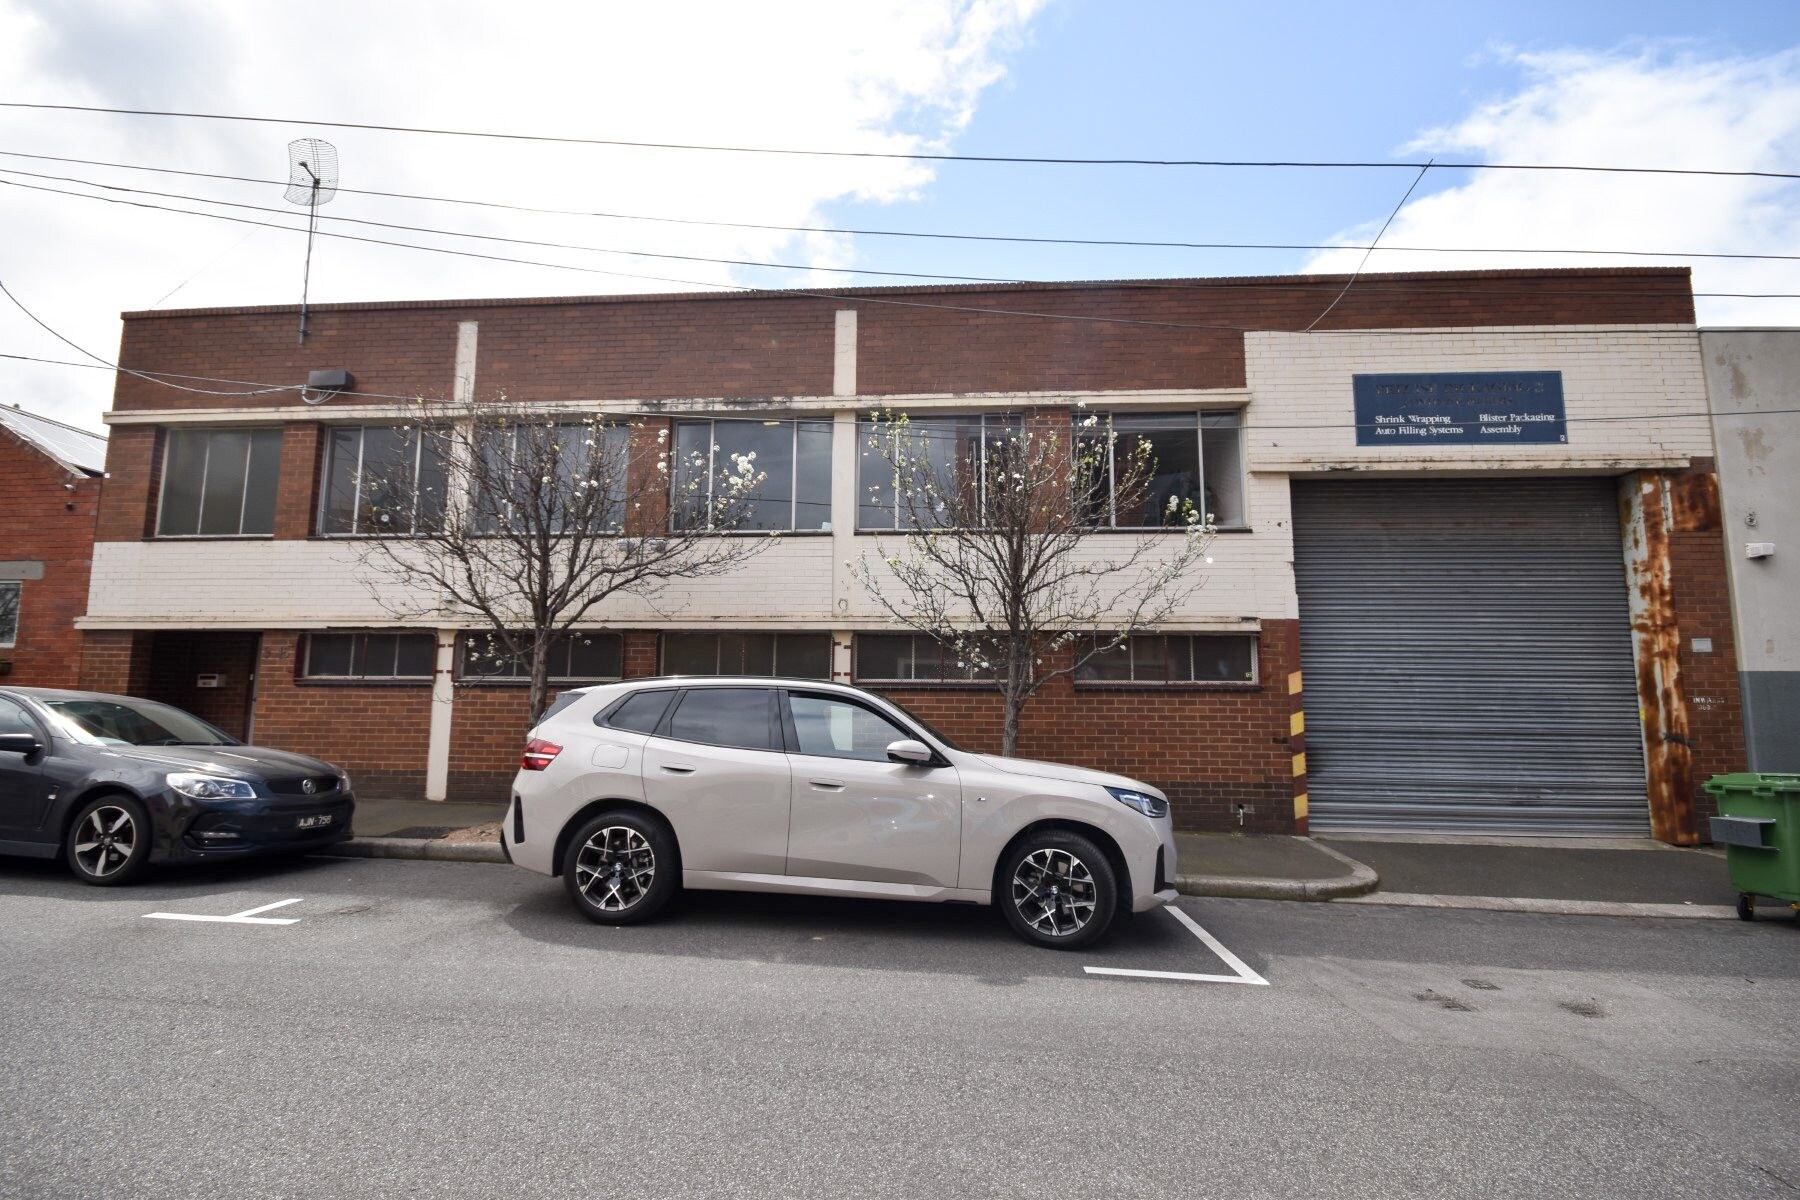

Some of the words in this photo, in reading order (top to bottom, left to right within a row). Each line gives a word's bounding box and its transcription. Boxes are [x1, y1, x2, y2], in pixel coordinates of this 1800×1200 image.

[1375, 415, 1405, 424] Shrink
[1408, 414, 1451, 425] Wrapping
[1479, 413, 1507, 422] Blister
[1509, 412, 1555, 423] Packaging
[1375, 427, 1396, 435] Auto
[1399, 426, 1427, 437] Filling
[1429, 426, 1464, 436] Systems
[1480, 425, 1522, 435] Assembly
